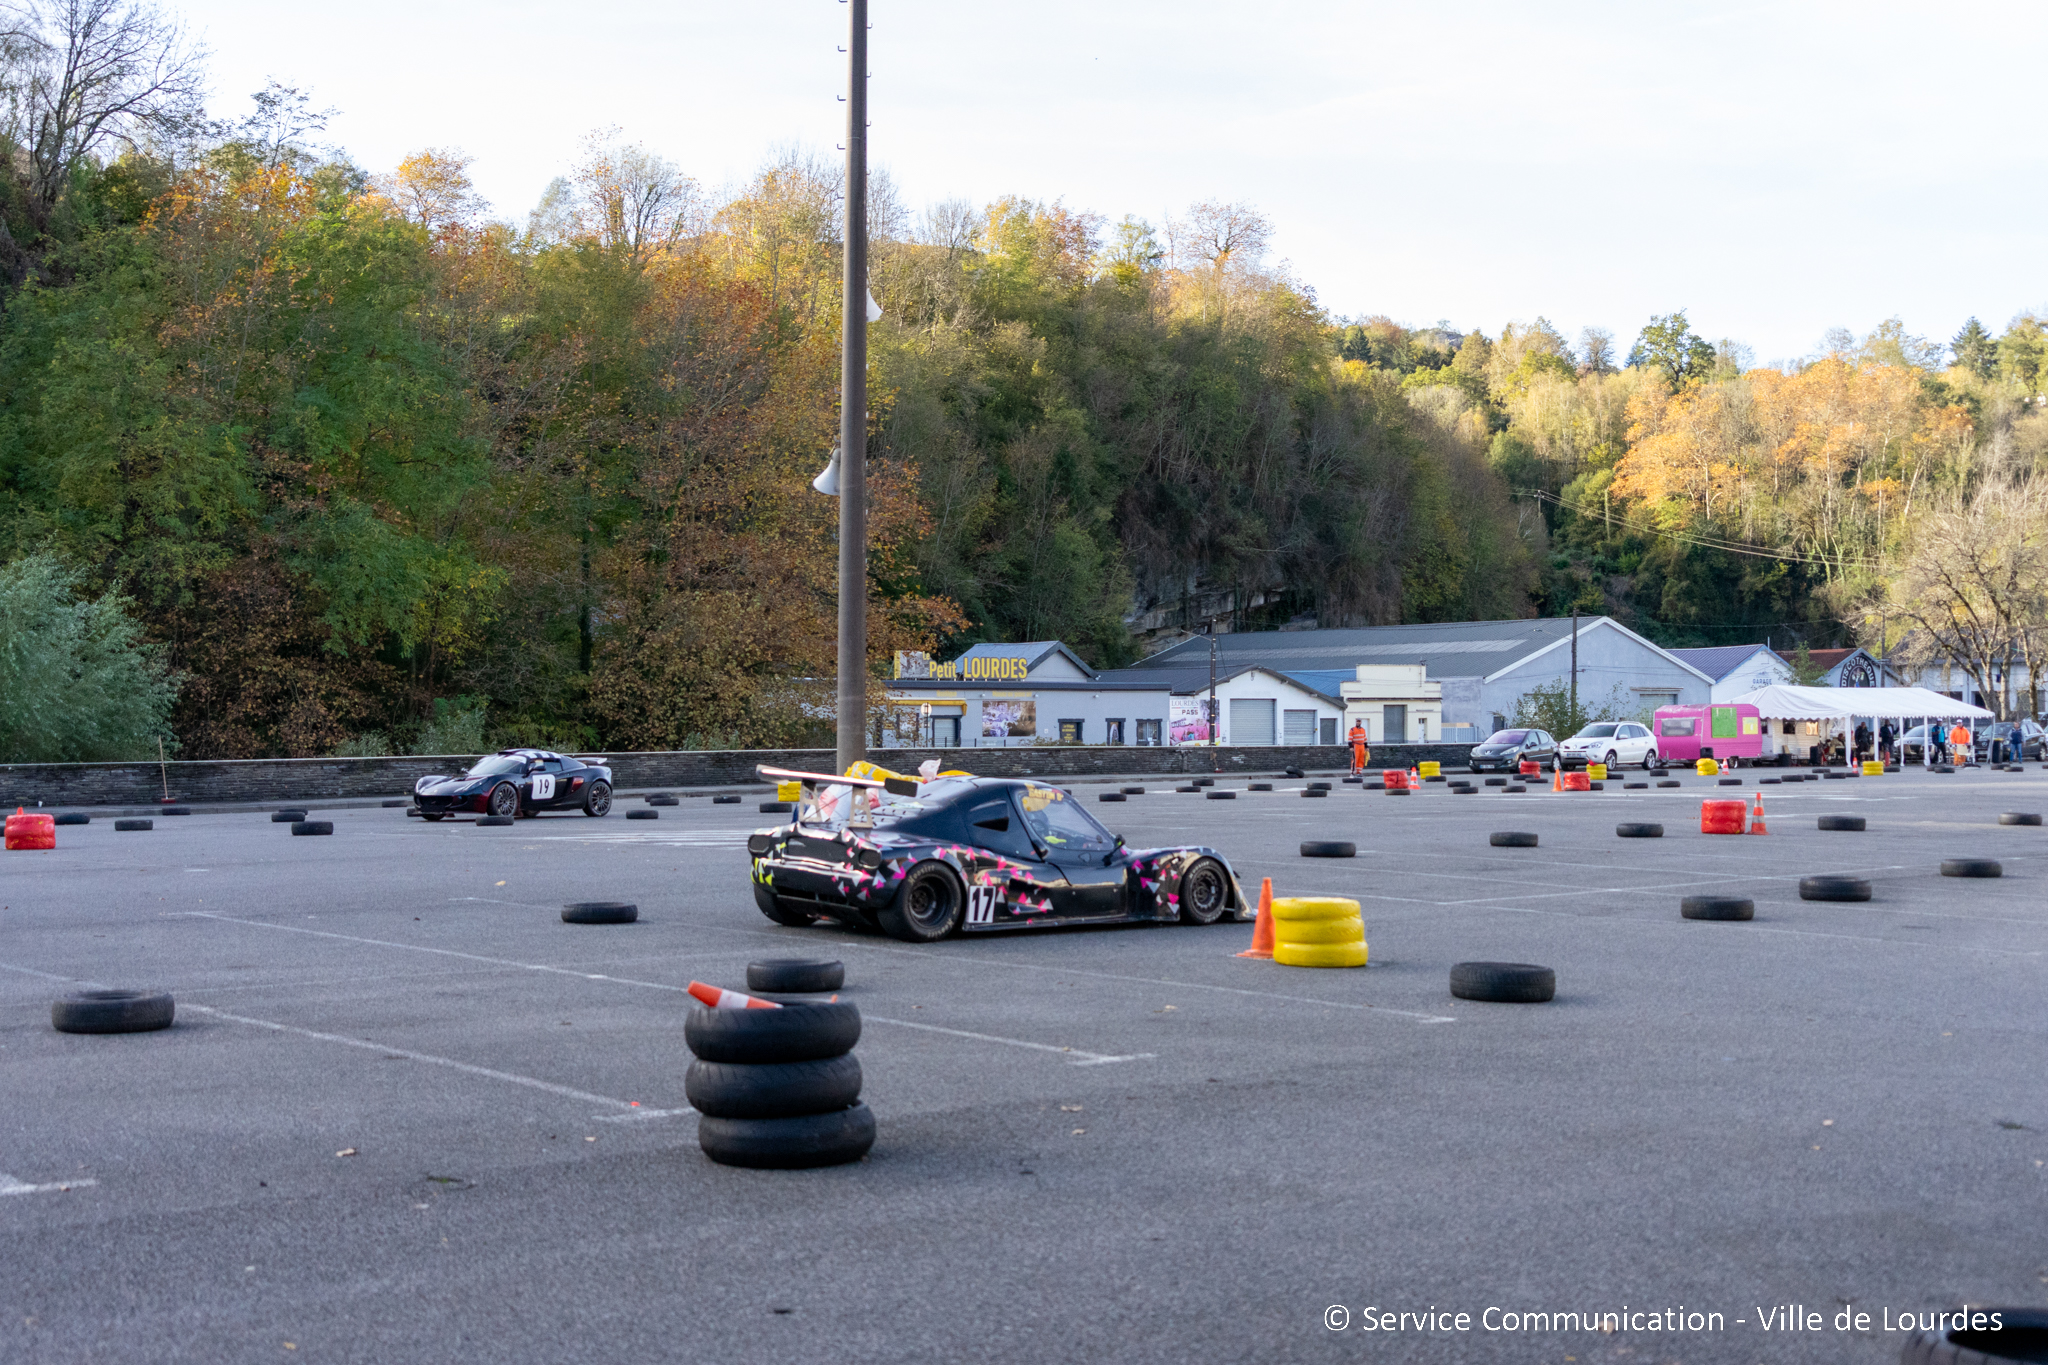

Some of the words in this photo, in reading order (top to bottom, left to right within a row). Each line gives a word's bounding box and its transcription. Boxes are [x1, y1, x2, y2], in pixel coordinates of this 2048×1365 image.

[922, 651, 930, 660] Le
[929, 660, 957, 678] Petit
[963, 657, 1028, 679] LOURDES
[1841, 656, 1876, 687] DISCOTHEQUE
[539, 778, 550, 794] 19
[972, 887, 994, 921] 17
